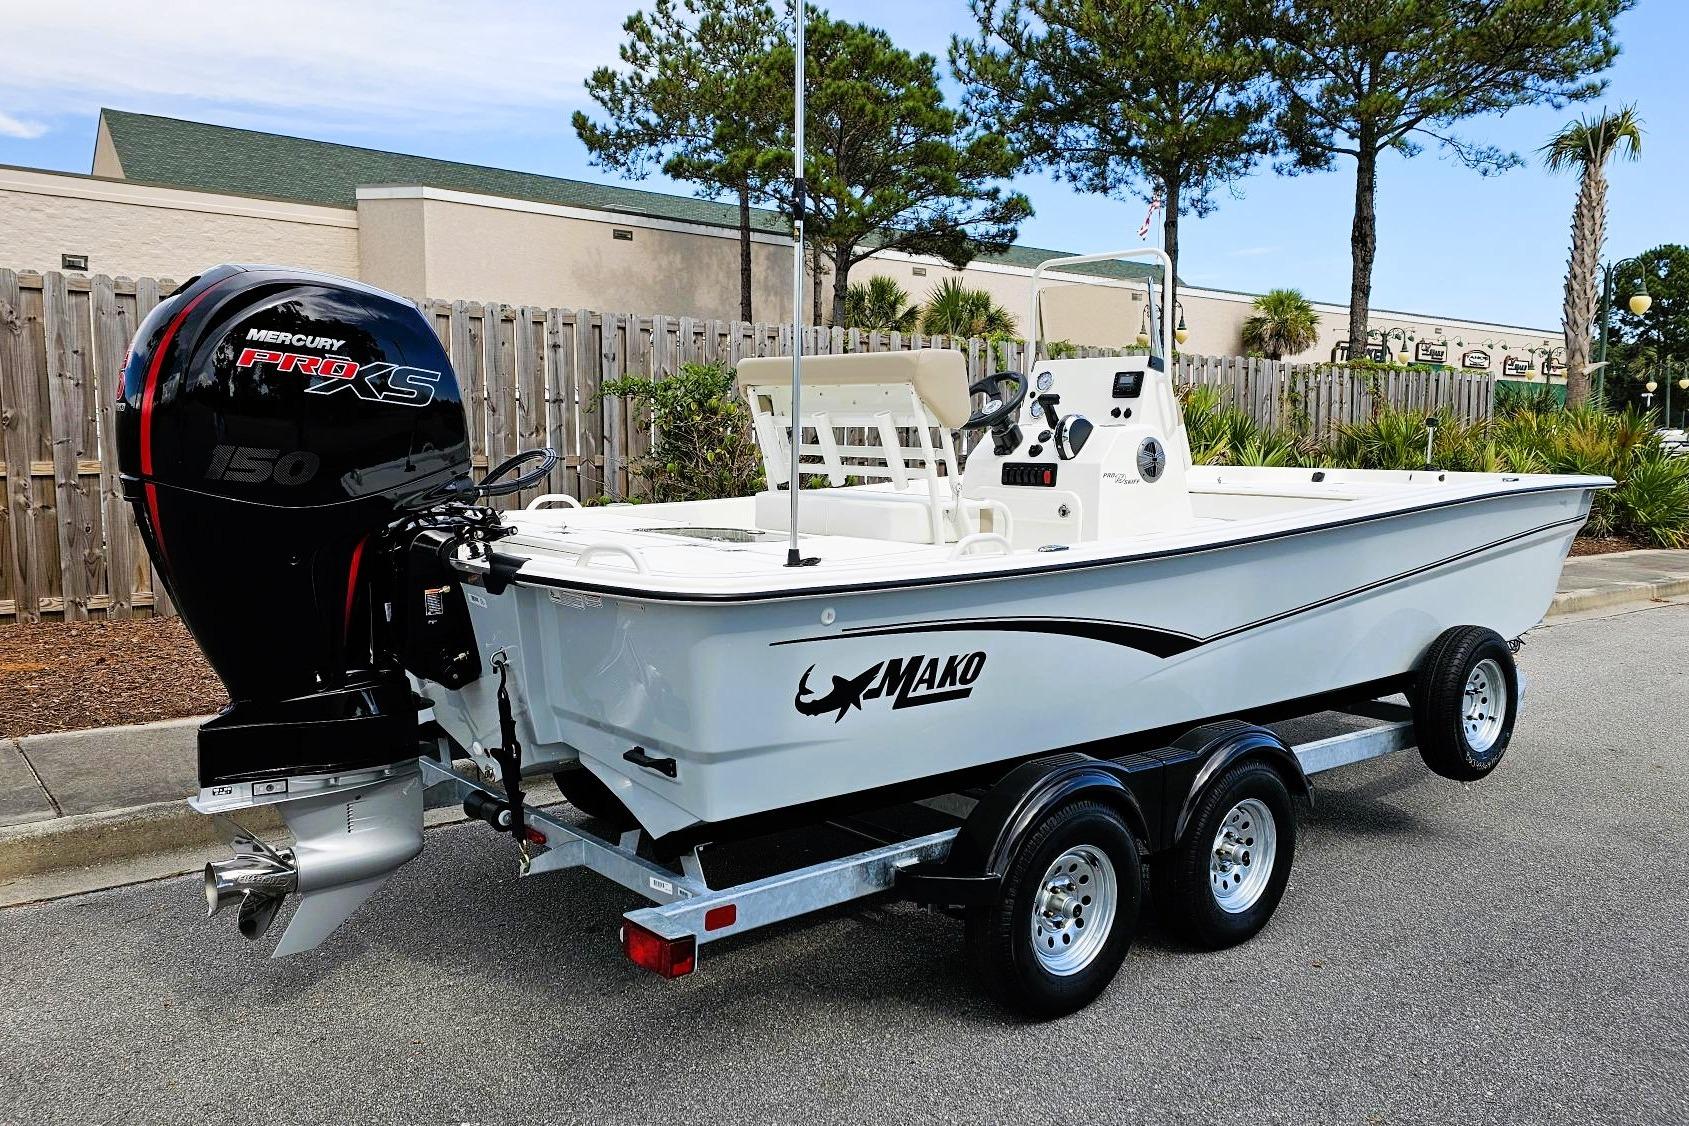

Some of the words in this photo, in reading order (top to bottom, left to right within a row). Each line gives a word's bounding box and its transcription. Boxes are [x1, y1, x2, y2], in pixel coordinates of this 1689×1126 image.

[246, 328, 346, 351] MERCURY
[236, 347, 360, 380] PRO
[303, 353, 442, 407] XS
[207, 444, 320, 485] 150
[862, 651, 987, 710] MAKO
